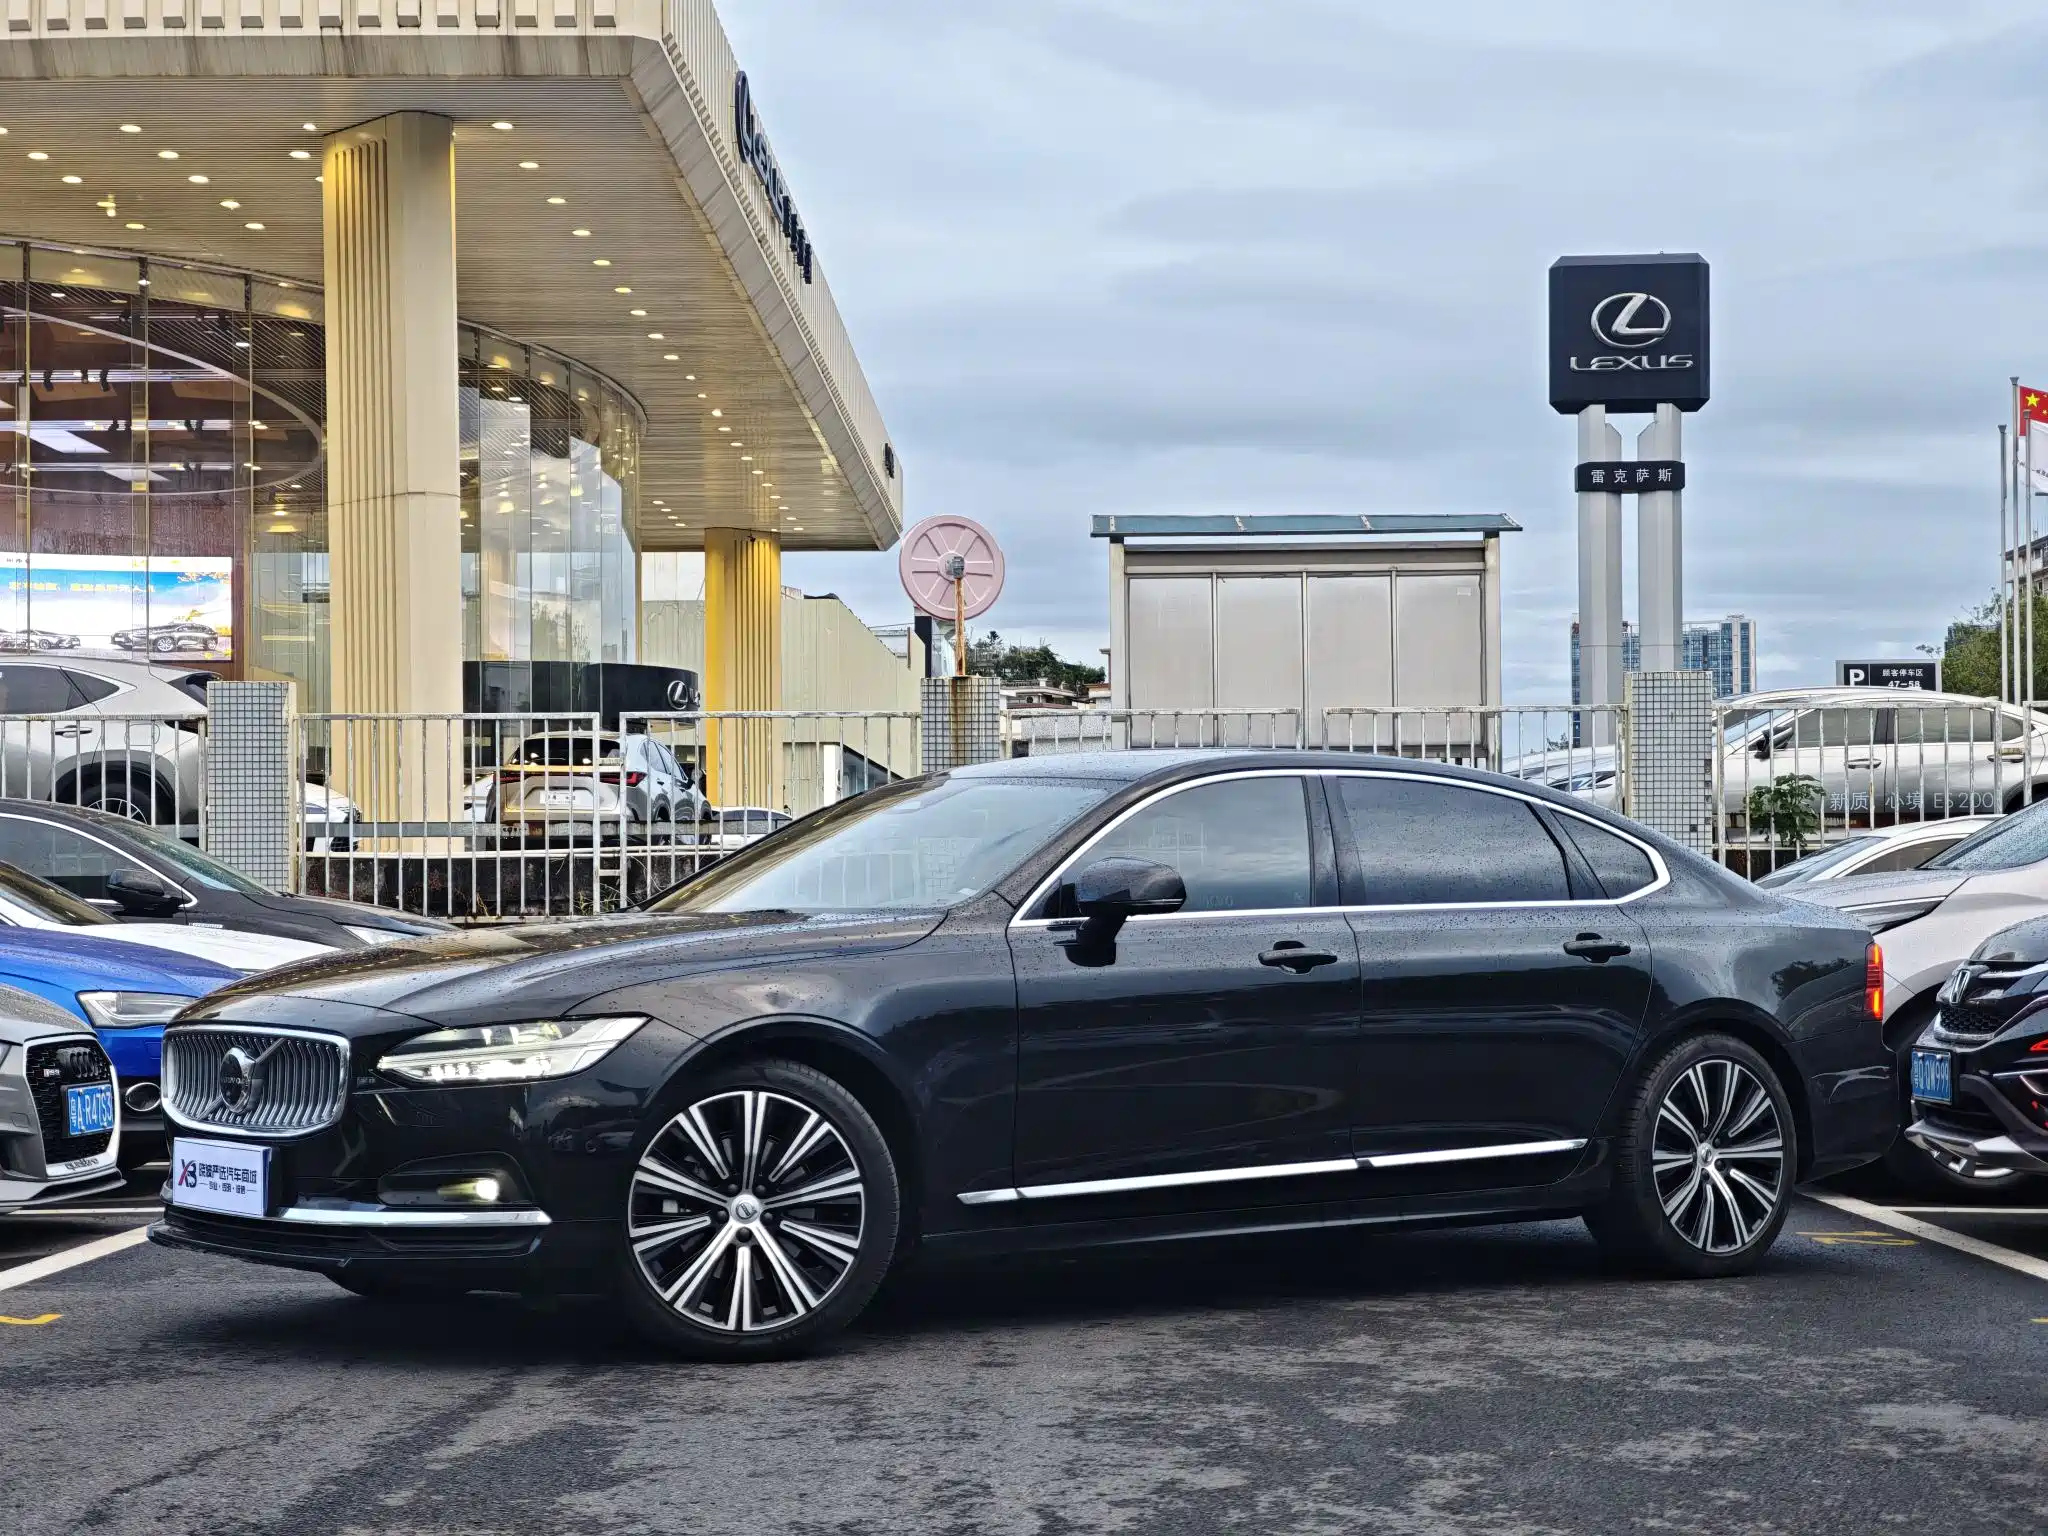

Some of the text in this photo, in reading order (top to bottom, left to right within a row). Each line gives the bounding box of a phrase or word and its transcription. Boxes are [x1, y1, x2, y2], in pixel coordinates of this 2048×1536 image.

[1570, 354, 1694, 372] LEXUS
[1591, 468, 1673, 484] 雷克萨斯
[1849, 668, 1924, 686] P 顾客停车区
